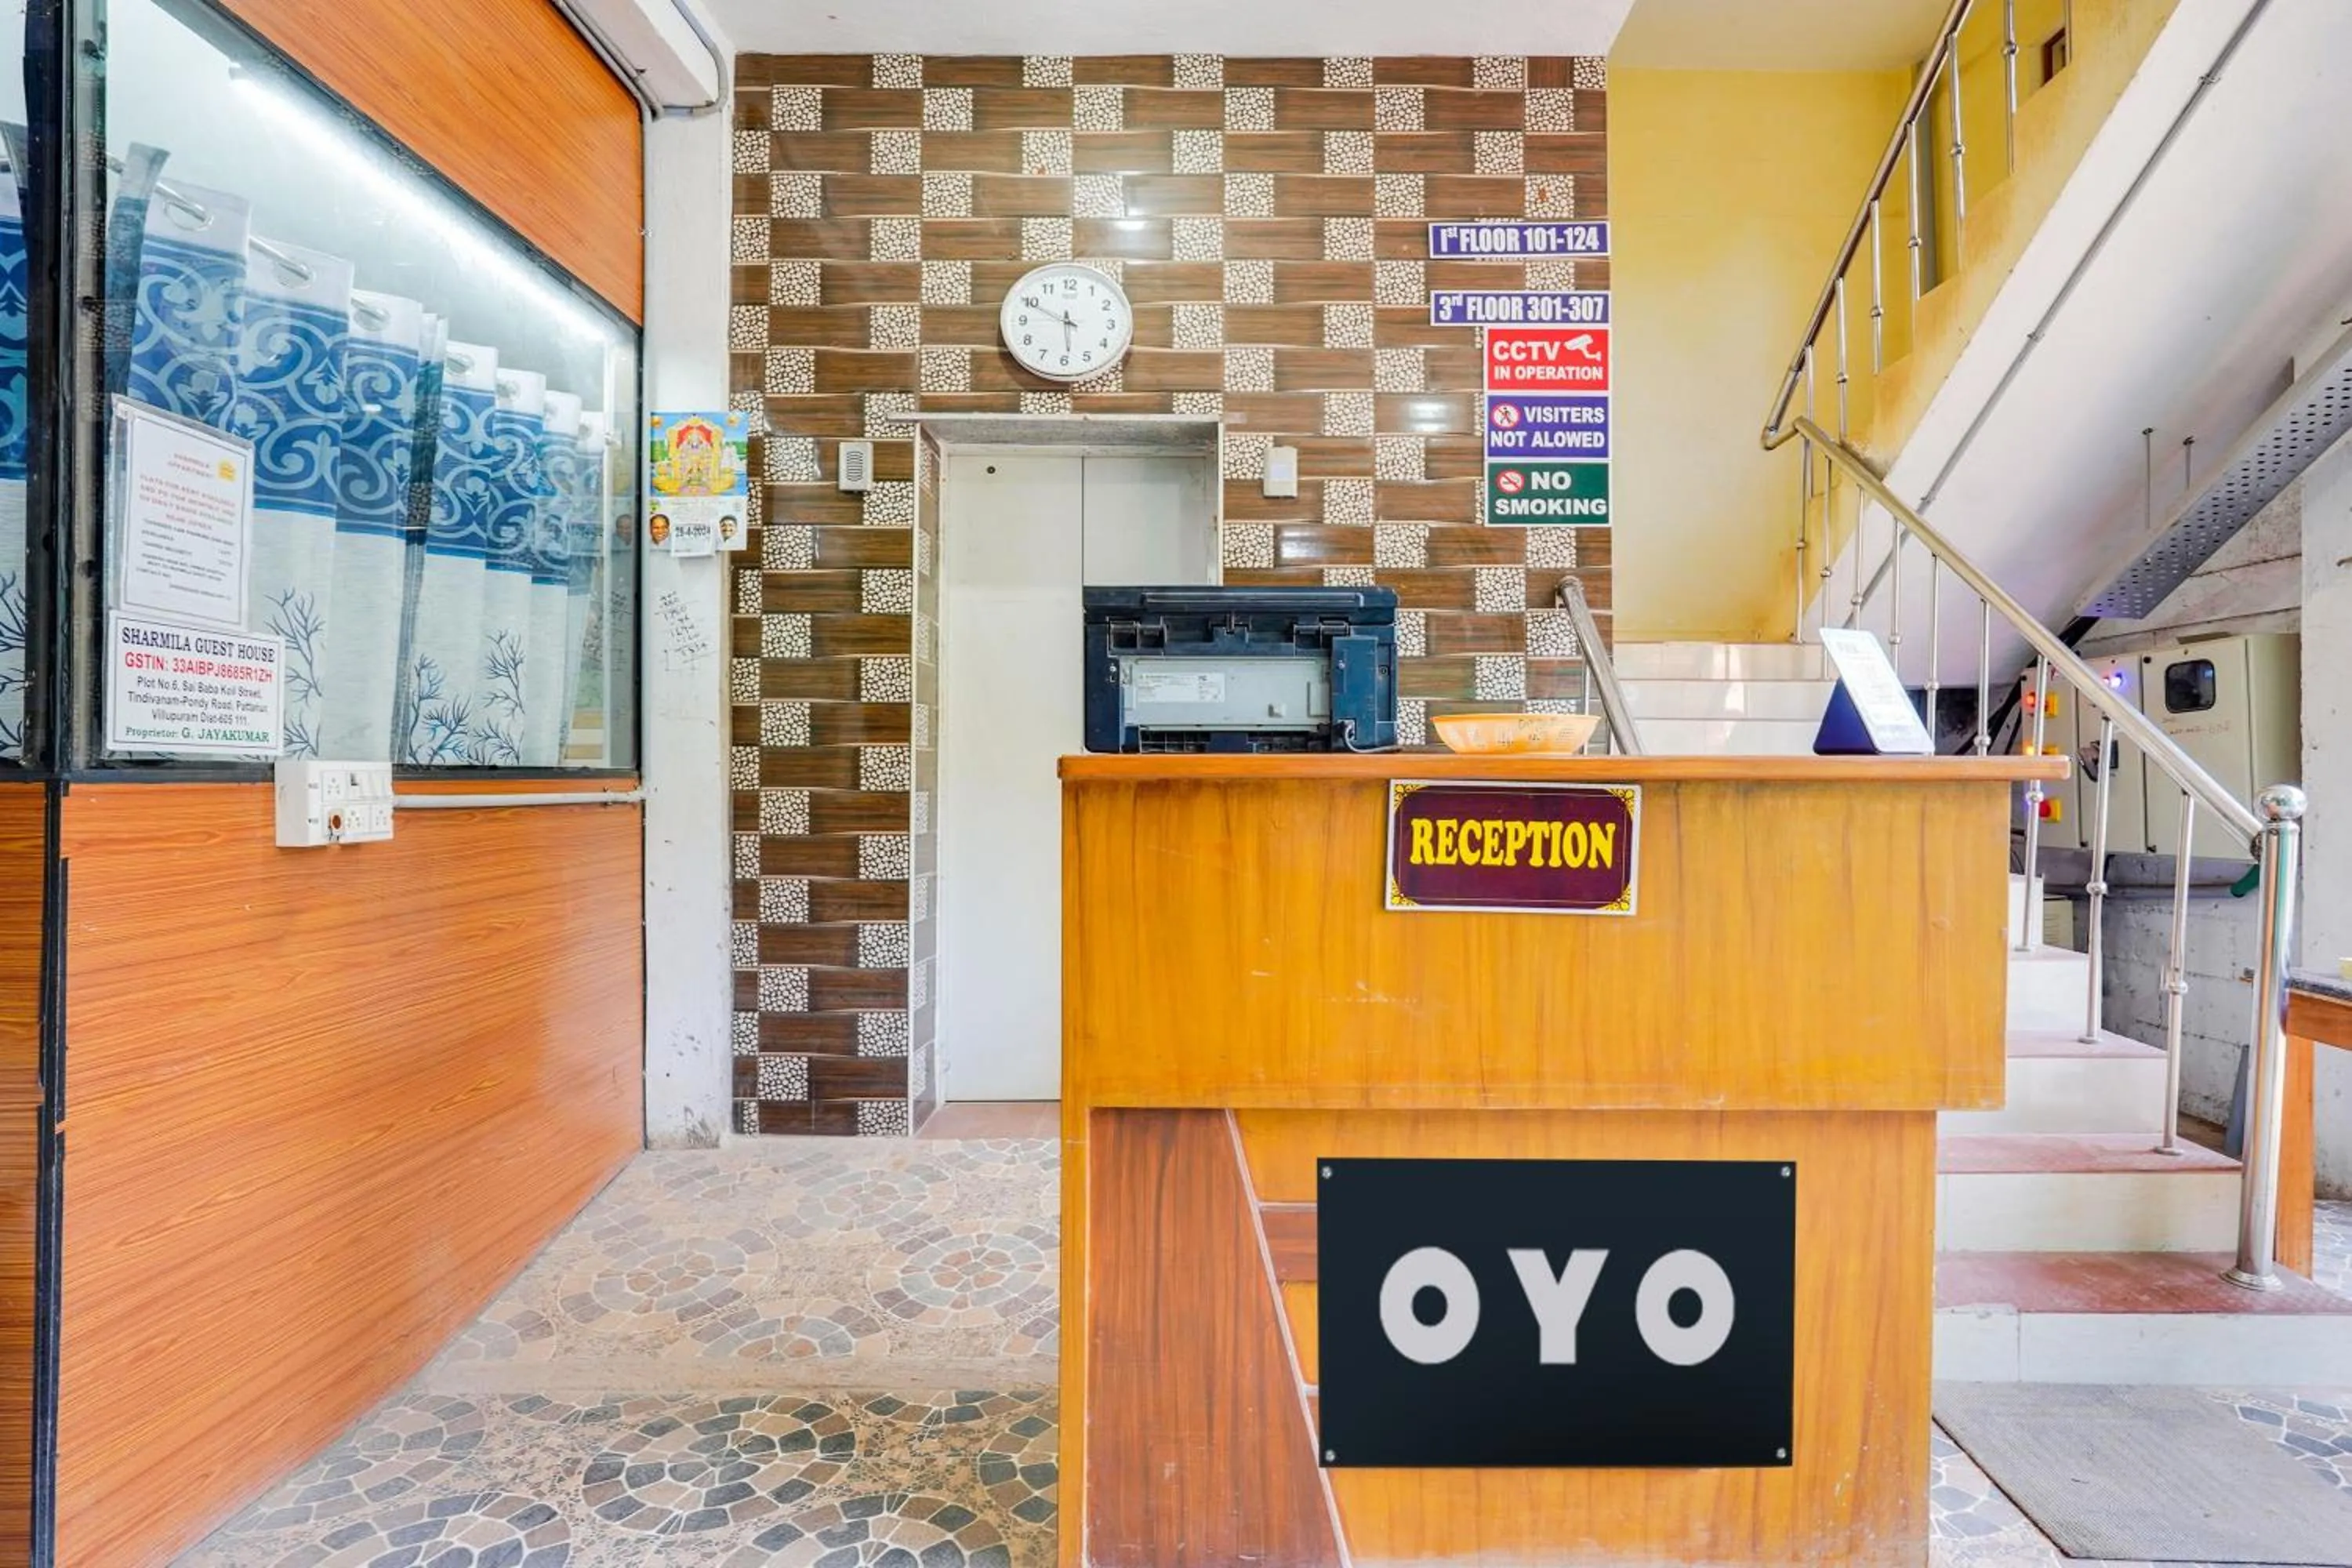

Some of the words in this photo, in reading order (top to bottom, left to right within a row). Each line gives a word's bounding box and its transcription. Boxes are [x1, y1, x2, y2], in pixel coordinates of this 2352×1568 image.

[1459, 227, 1520, 252] FLOOR
[1523, 226, 1599, 251] 101-124
[1042, 283, 1054, 295] 11
[1063, 278, 1077, 290] 12
[1089, 285, 1094, 296] 1
[1022, 297, 1039, 308] 10
[1102, 299, 1111, 311] 2
[1439, 294, 1463, 321] 3rd
[1466, 296, 1523, 321] FLOOR
[1527, 295, 1604, 321] 301-307
[1018, 315, 1028, 325] 9
[1106, 319, 1116, 330] 3
[1023, 334, 1032, 345] 8
[1099, 338, 1107, 349] 4
[1039, 349, 1048, 360] 7
[1082, 351, 1091, 361] 5
[1493, 340, 1561, 361] CCTV
[1060, 355, 1069, 366] 6
[1494, 365, 1511, 379] IN
[1515, 365, 1603, 380] OPERATION
[1523, 406, 1605, 423] VISITERS
[1490, 430, 1527, 448] NOT
[1531, 431, 1605, 448] ALOWED
[1531, 471, 1571, 490] NO
[1495, 499, 1606, 515] SMOKING
[122, 626, 191, 652] SHARMILA
[195, 637, 234, 658] GUEST
[238, 644, 275, 663] HOUSE
[125, 652, 168, 672] GSTIN:
[198, 728, 270, 743] JAYAKUMAR
[1410, 818, 1616, 869] RECEPTION
[1379, 1246, 1735, 1367] OYO
